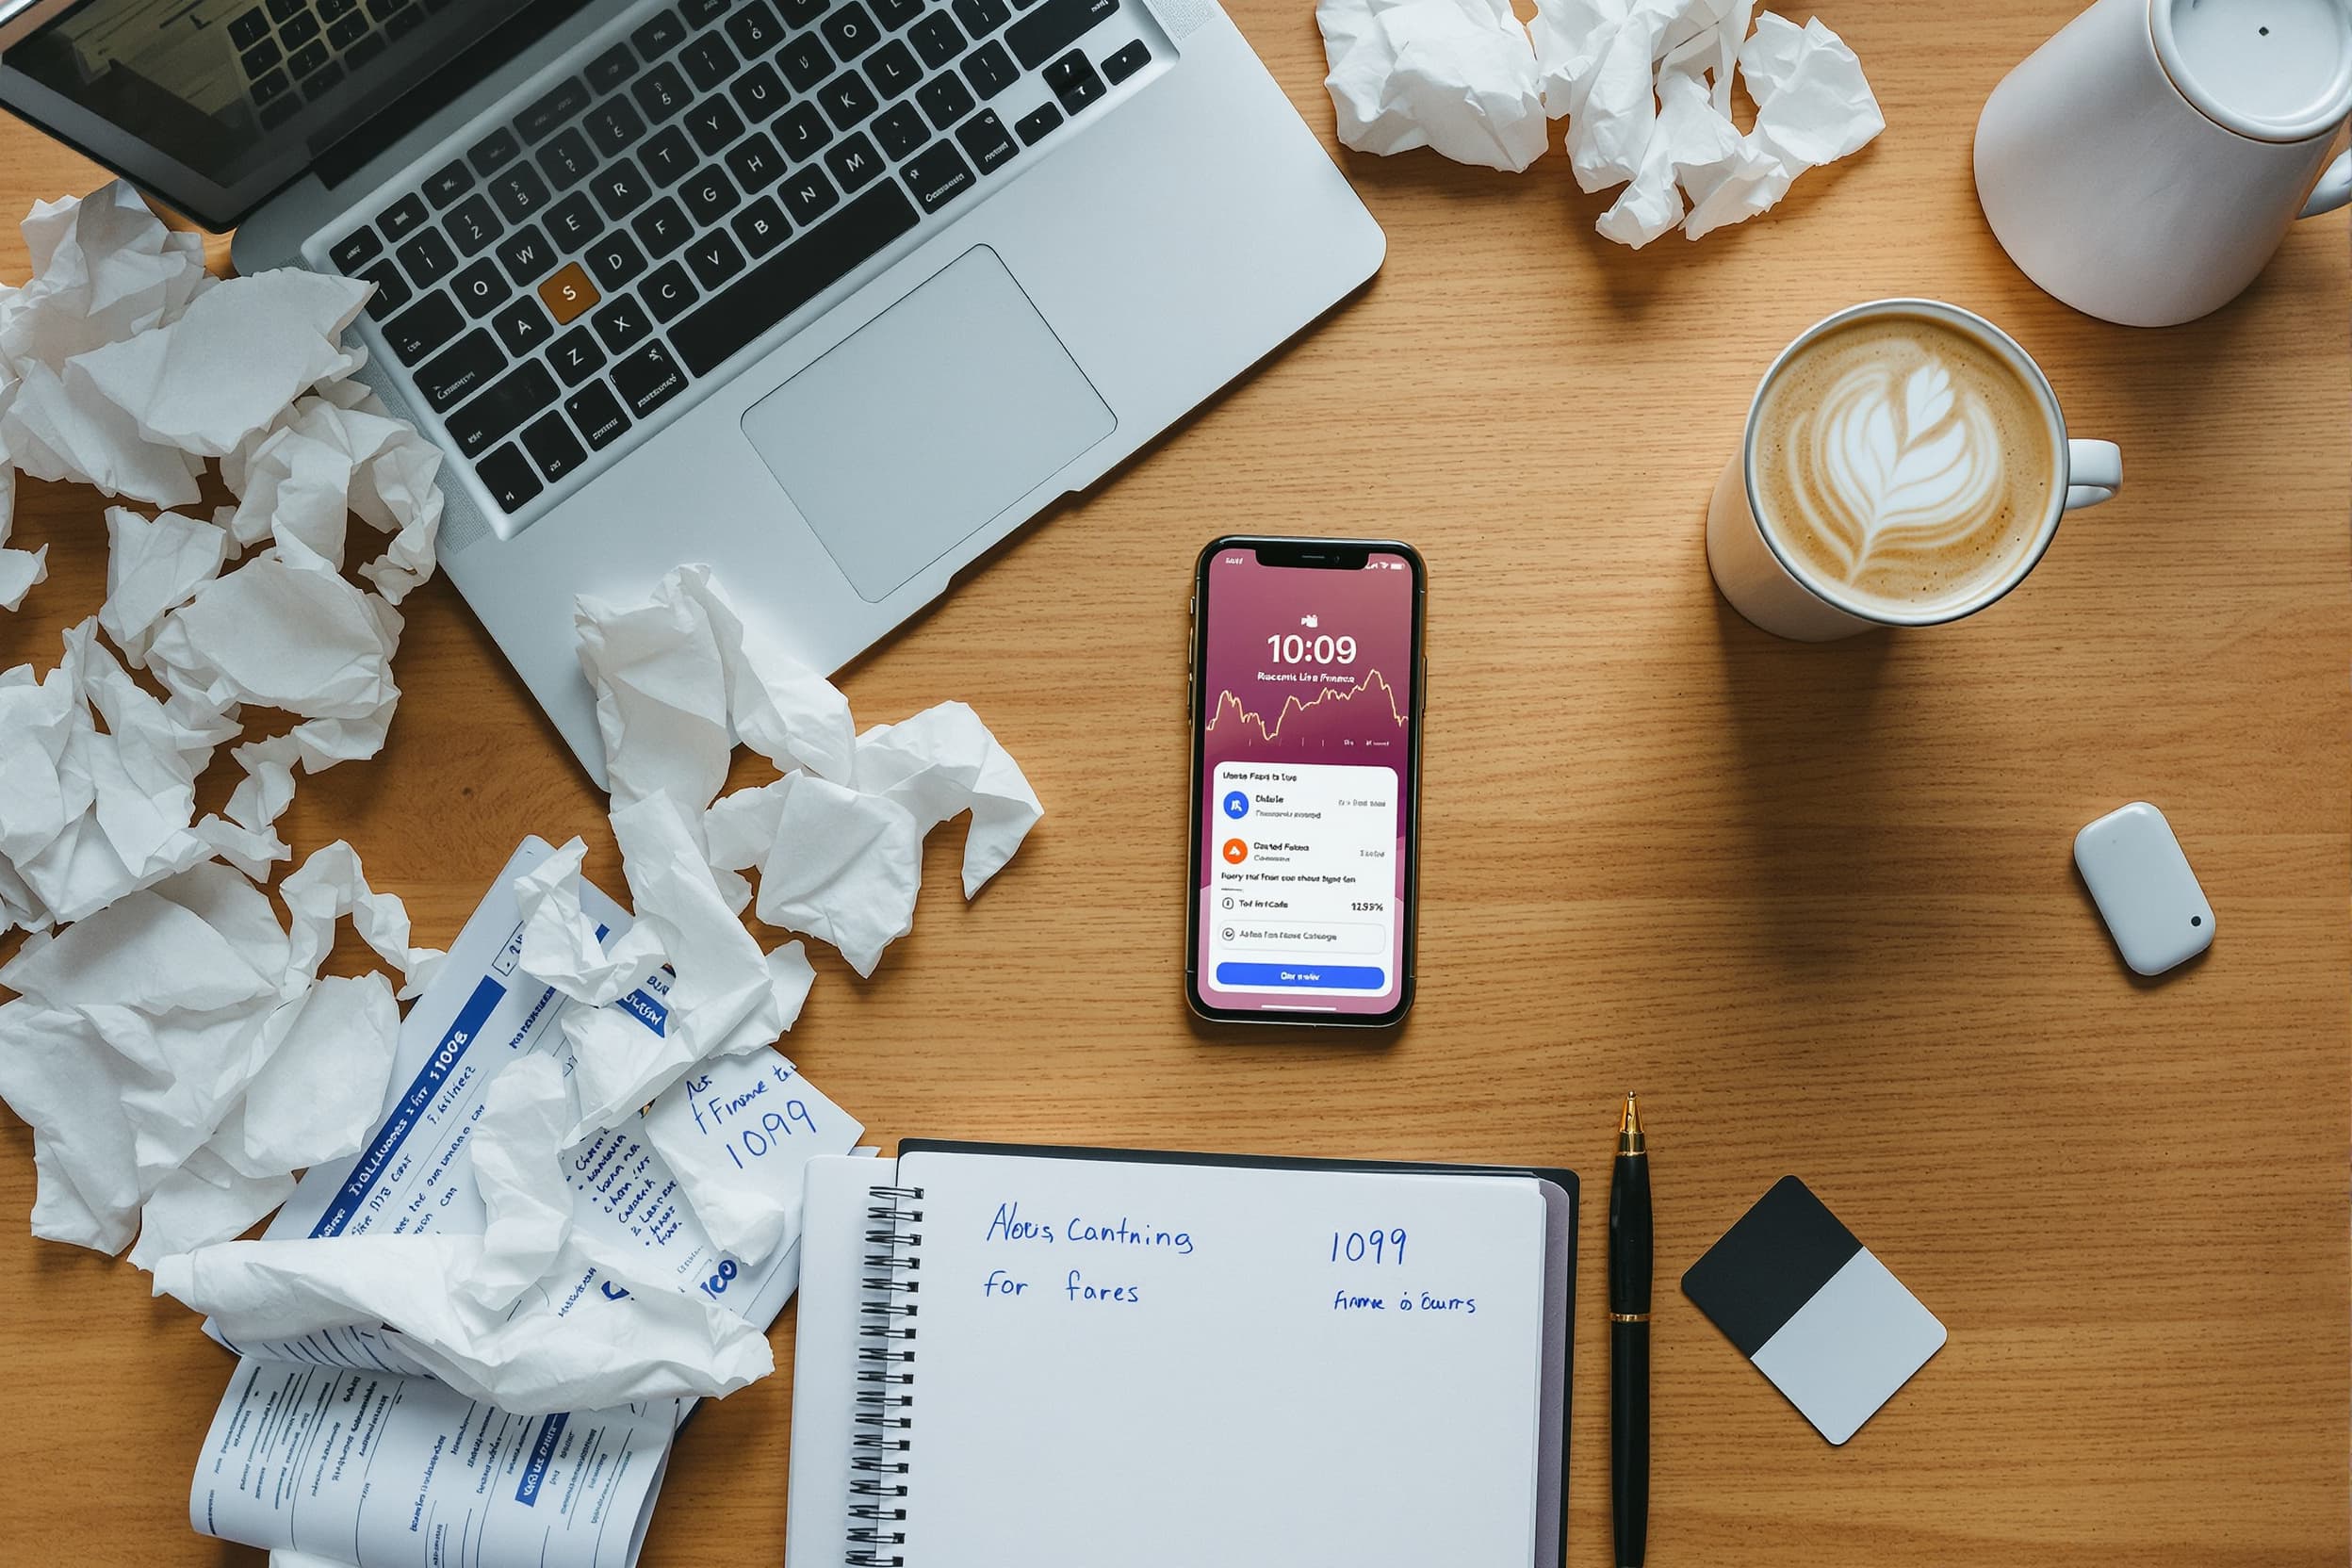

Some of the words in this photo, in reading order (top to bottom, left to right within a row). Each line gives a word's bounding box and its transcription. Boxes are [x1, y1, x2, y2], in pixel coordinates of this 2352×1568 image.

[515, 245, 534, 265] W
[565, 214, 580, 232] E
[612, 182, 629, 197] R
[659, 148, 671, 163] T
[707, 116, 718, 130] Y
[751, 85, 766, 100] U
[842, 24, 858, 39] O
[517, 319, 532, 335] A
[563, 285, 577, 301] S
[608, 253, 623, 270] D
[655, 220, 665, 235] F
[702, 187, 717, 203] G
[747, 155, 763, 172] H
[798, 124, 808, 140] J
[840, 92, 857, 108] K
[886, 63, 900, 76] L
[566, 348, 584, 367] Z
[613, 316, 631, 333] X
[662, 284, 677, 299] C
[707, 250, 719, 265] V
[754, 220, 769, 235] B
[800, 186, 816, 204] N
[845, 153, 865, 172] M
[1266, 633, 1357, 664] 10:09
[726, 1099, 817, 1170] 1099
[1331, 1227, 1407, 1266] 1099
[1065, 1268, 1139, 1302] fares
